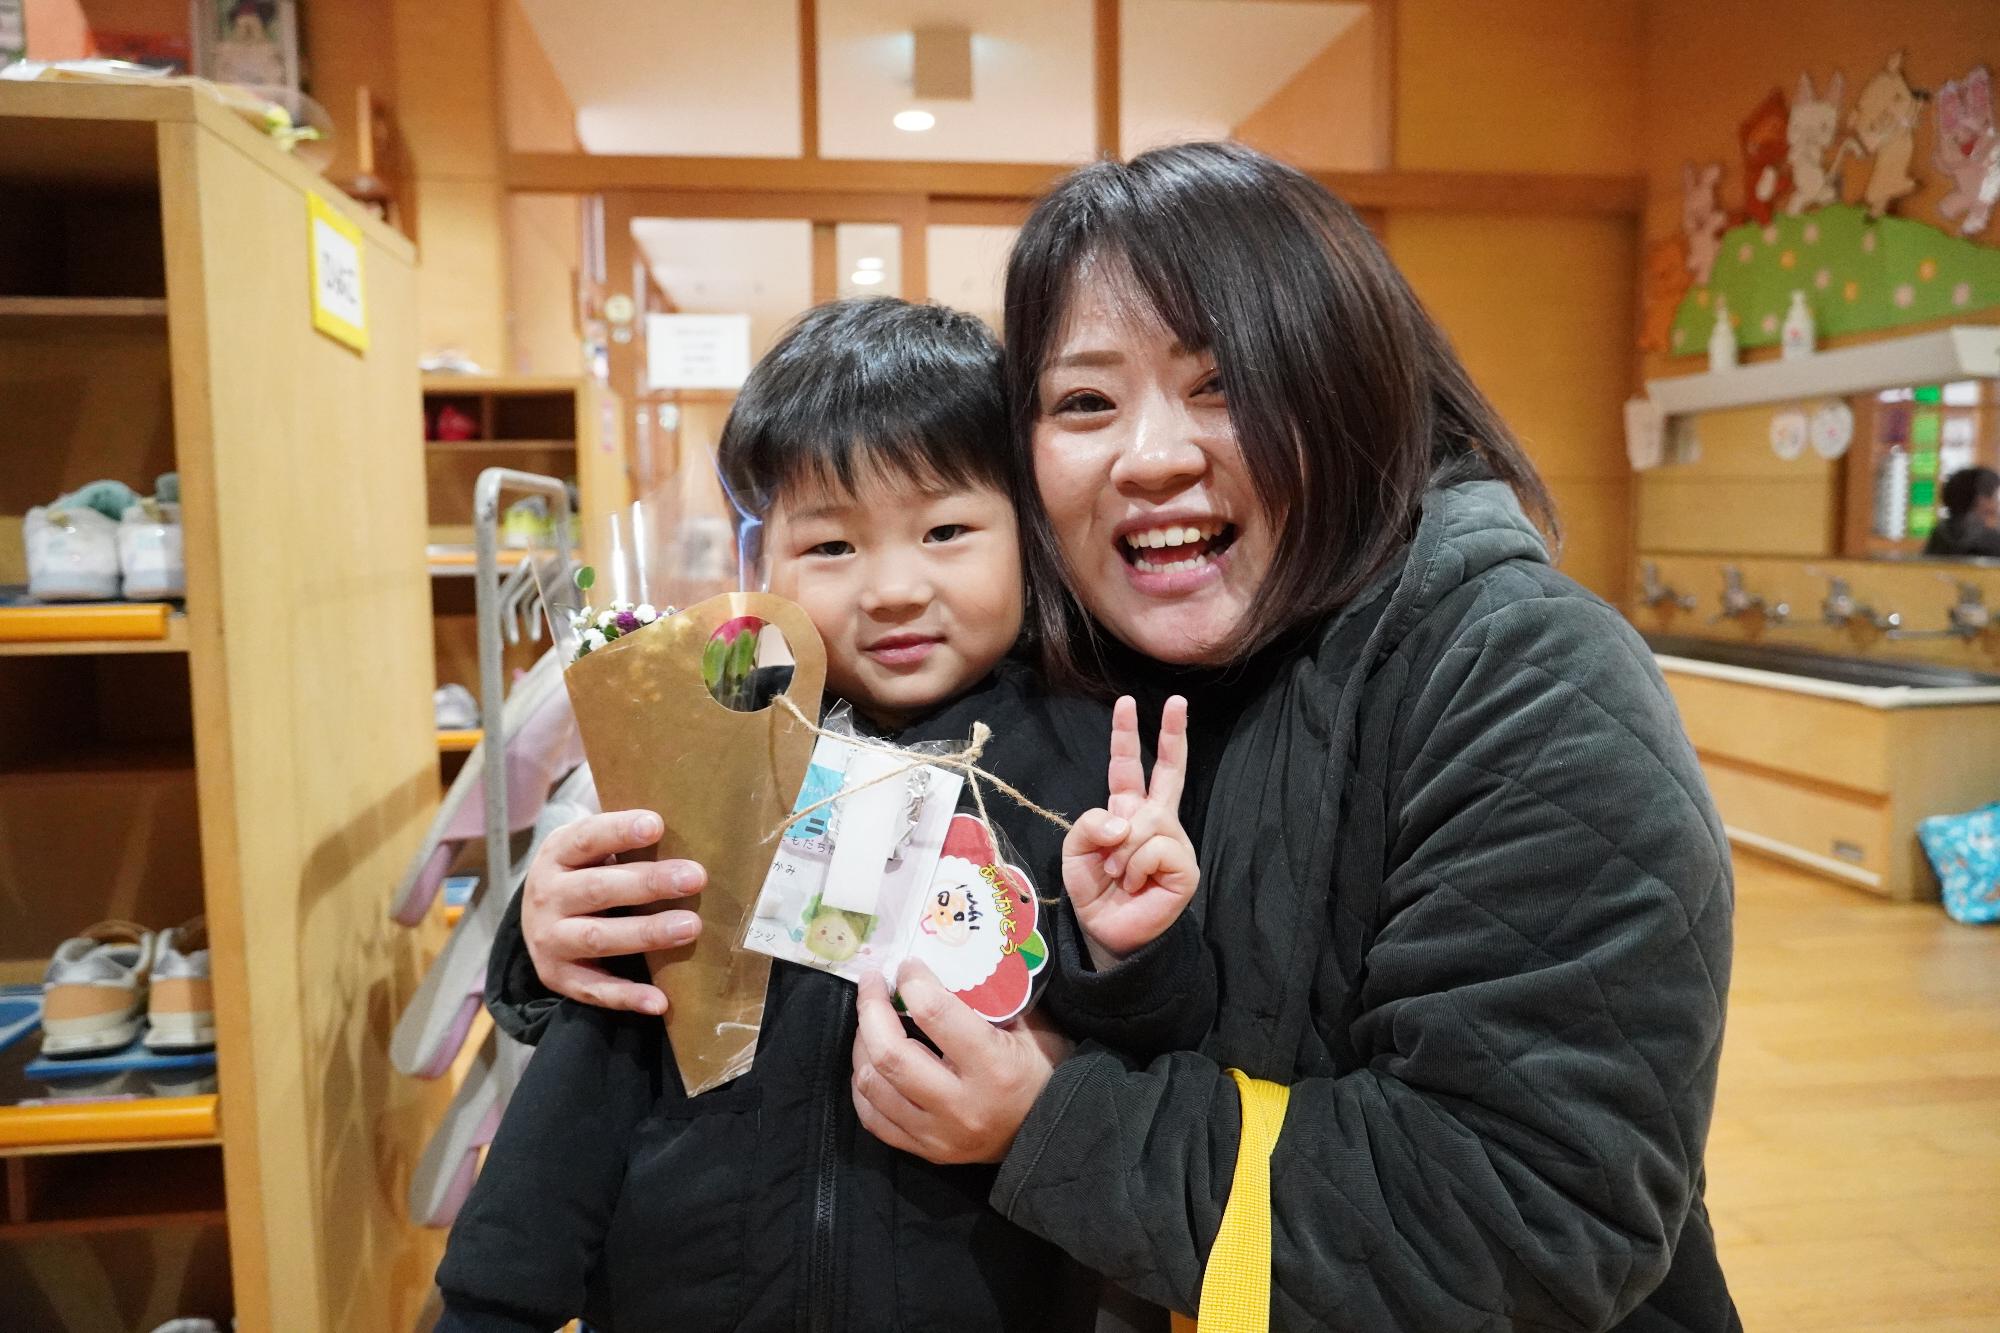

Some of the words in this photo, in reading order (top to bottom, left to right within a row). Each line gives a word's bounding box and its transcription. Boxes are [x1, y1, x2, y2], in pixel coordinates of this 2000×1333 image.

[979, 863, 1019, 955] ありがとう
